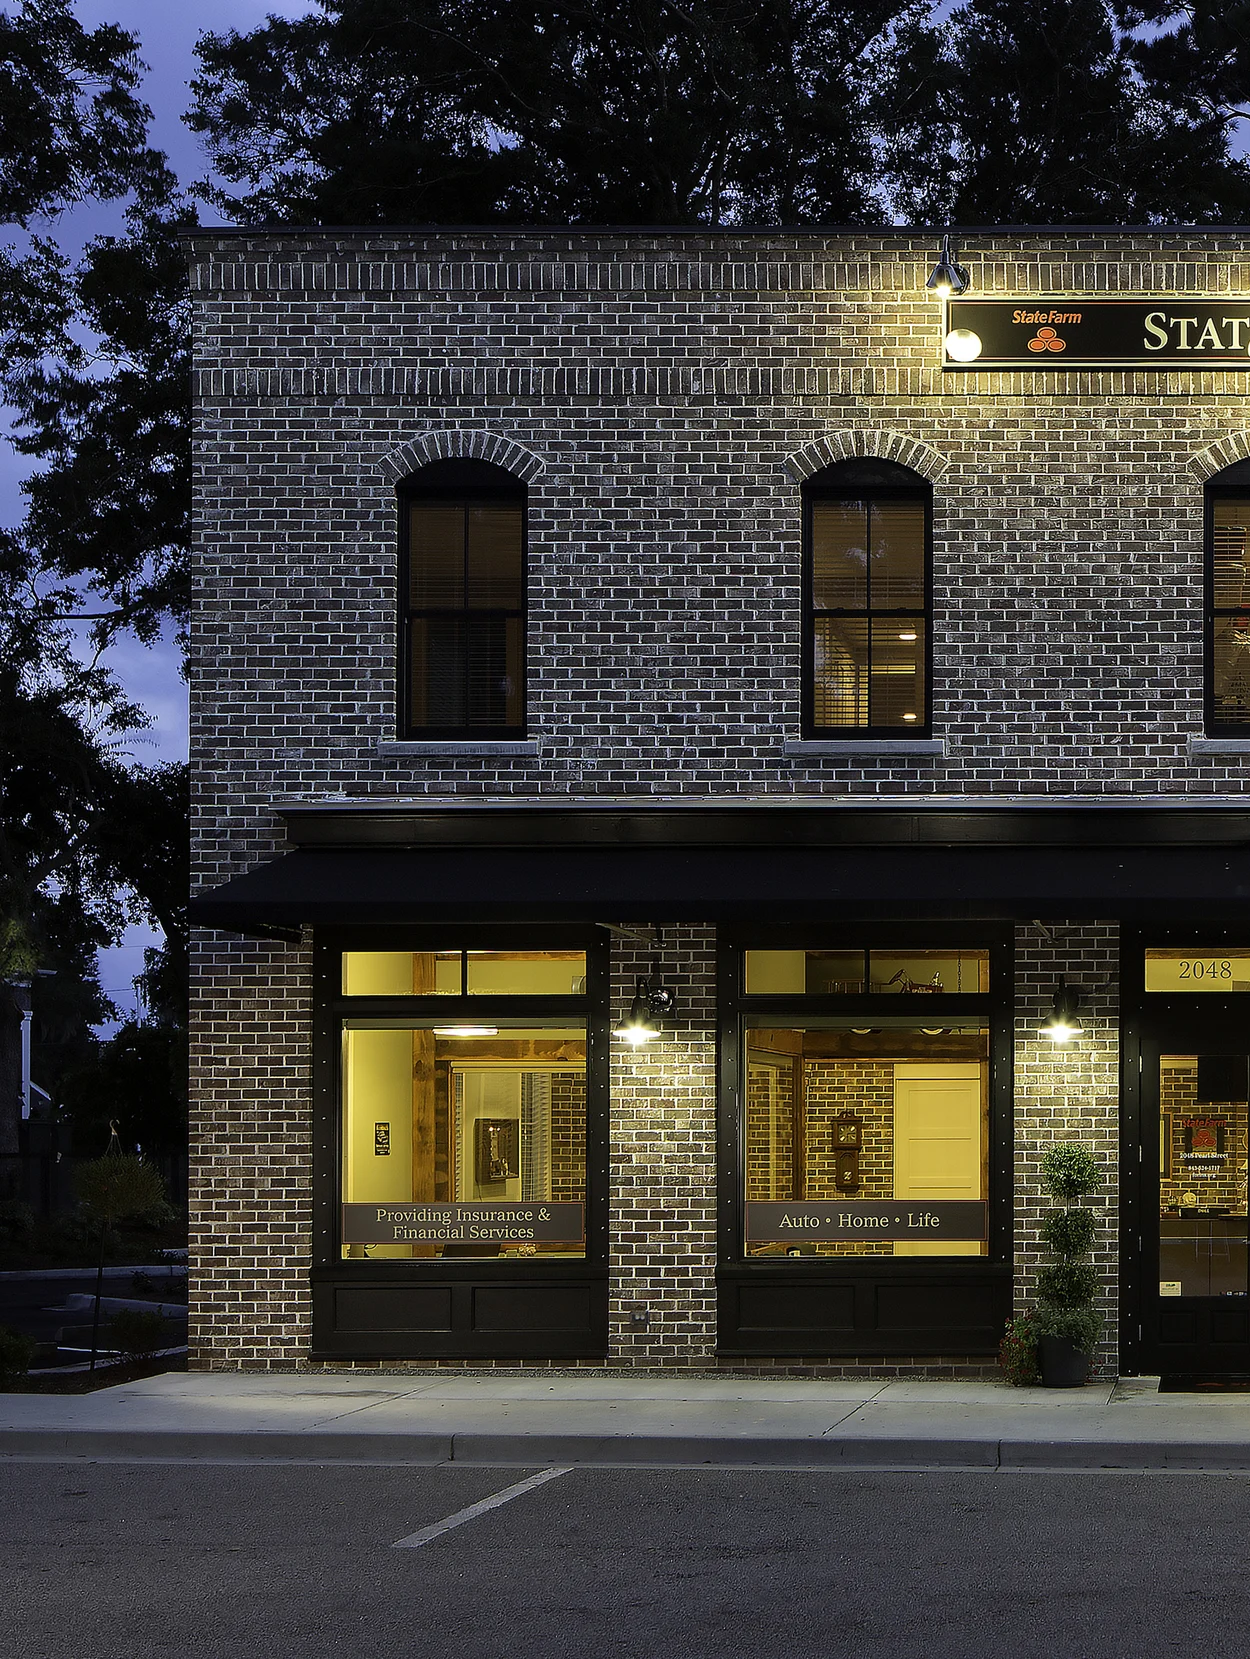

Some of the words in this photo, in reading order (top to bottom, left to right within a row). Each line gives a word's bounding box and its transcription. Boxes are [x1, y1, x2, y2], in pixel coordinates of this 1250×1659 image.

[1178, 960, 1233, 980] 2048
[376, 1207, 452, 1225] Providing
[456, 1207, 534, 1222] Insurance
[537, 1207, 552, 1222] &
[778, 1213, 821, 1229] Auto
[837, 1213, 890, 1229] Home
[907, 1212, 941, 1228] Life
[392, 1225, 464, 1240] Financial
[469, 1225, 535, 1240] Services
